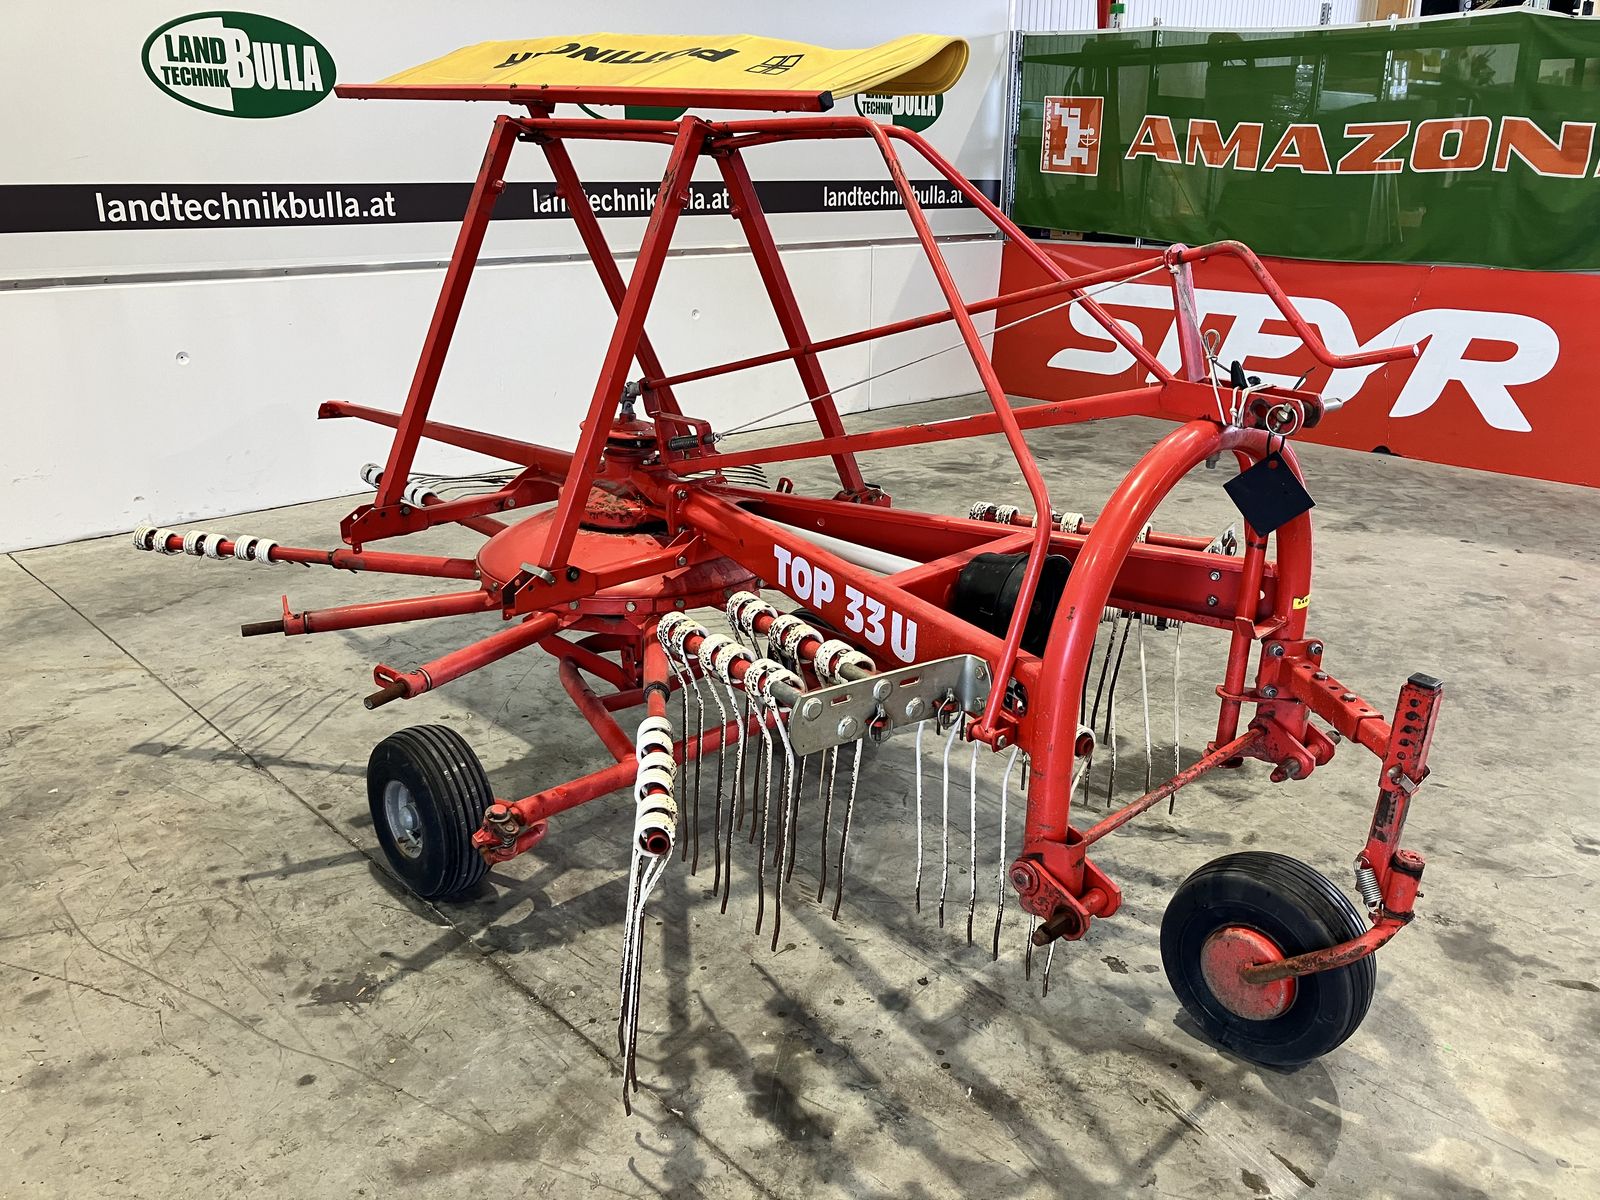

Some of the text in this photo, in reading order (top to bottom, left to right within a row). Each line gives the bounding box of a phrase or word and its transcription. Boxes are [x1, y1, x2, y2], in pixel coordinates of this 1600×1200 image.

[160, 66, 231, 88] TECHNIK
[165, 34, 227, 65] LAND
[222, 27, 324, 92] BULLA
[1125, 115, 1600, 178] AMAZON
[95, 191, 397, 222] landtechnikbulla.at
[1047, 281, 1560, 432] STEYR
[774, 544, 918, 664] TOP 33 U
